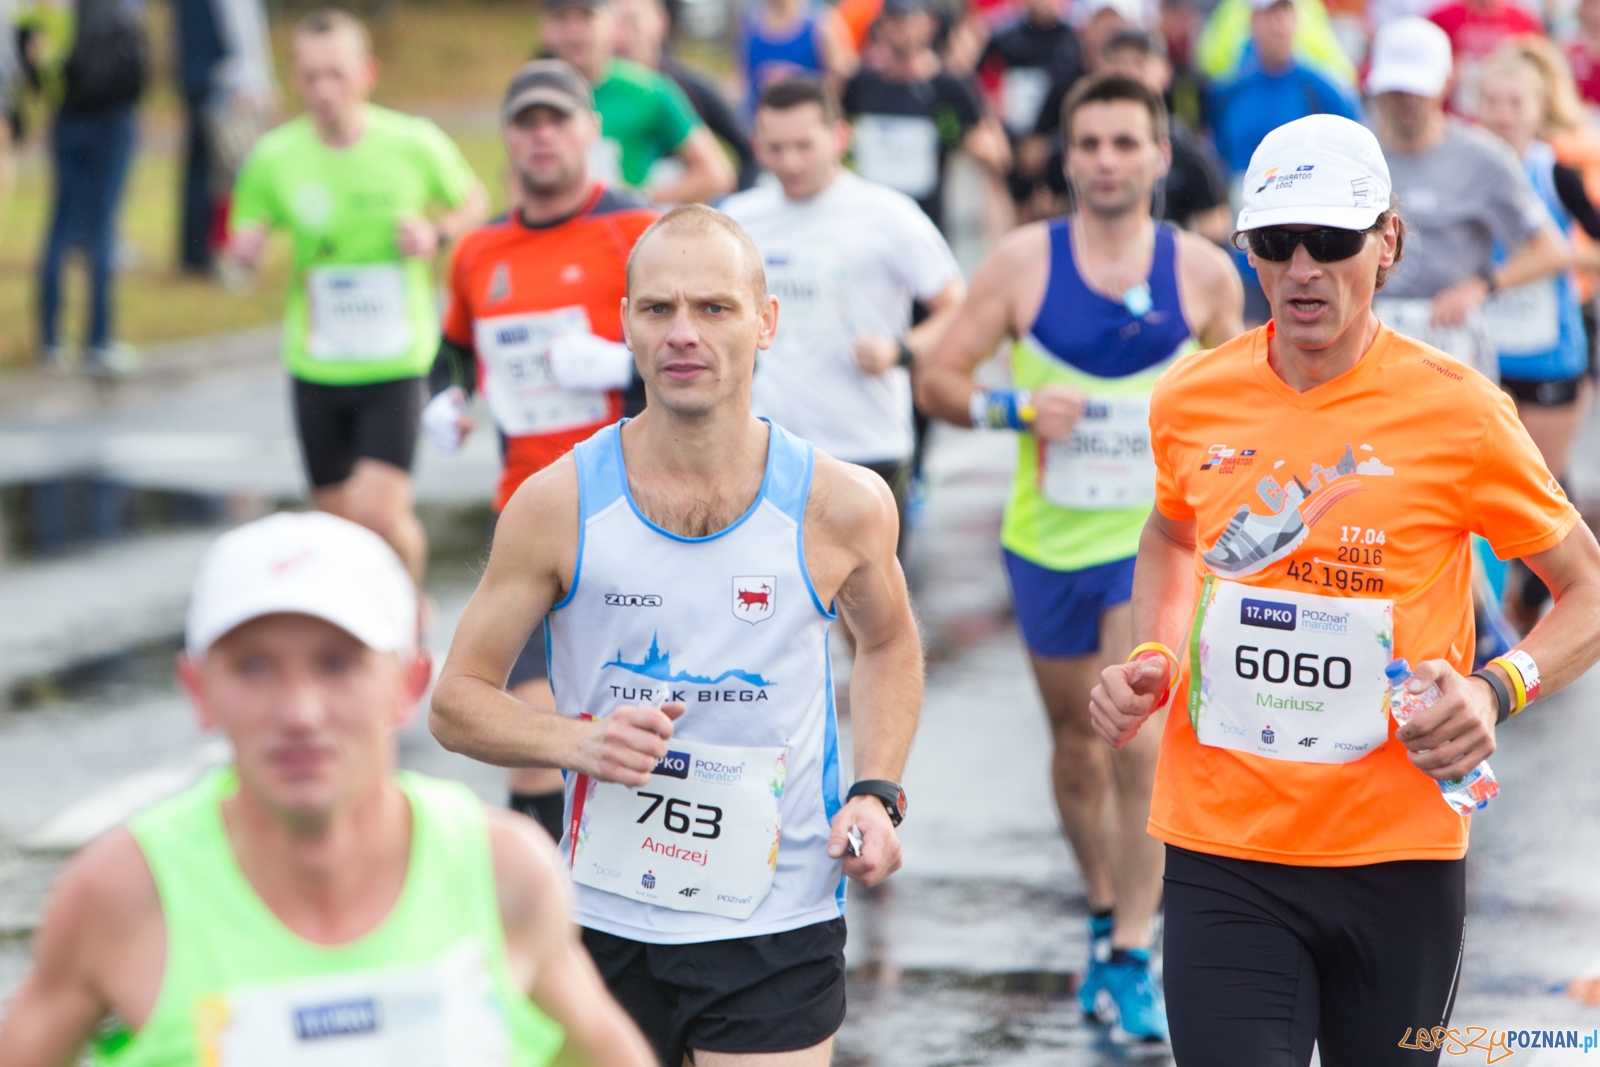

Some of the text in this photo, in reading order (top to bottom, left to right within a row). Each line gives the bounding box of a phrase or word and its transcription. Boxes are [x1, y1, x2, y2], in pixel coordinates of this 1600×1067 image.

[1278, 173, 1312, 183] MARATON
[1422, 358, 1464, 382] newline
[1222, 458, 1253, 466] MARATON
[1340, 525, 1386, 546] 17.04
[1337, 546, 1382, 565] 2016
[1286, 560, 1384, 592] 42.195m
[1301, 620, 1347, 632] maraton
[1235, 644, 1352, 690] 6060
[609, 685, 768, 702] TURK BIEGA
[1256, 692, 1324, 713] Mariusz
[1298, 737, 1319, 747] 4F
[694, 769, 741, 783] maraton
[636, 791, 723, 840] 763
[641, 836, 708, 866] Andrzej
[678, 887, 701, 898] 4F
